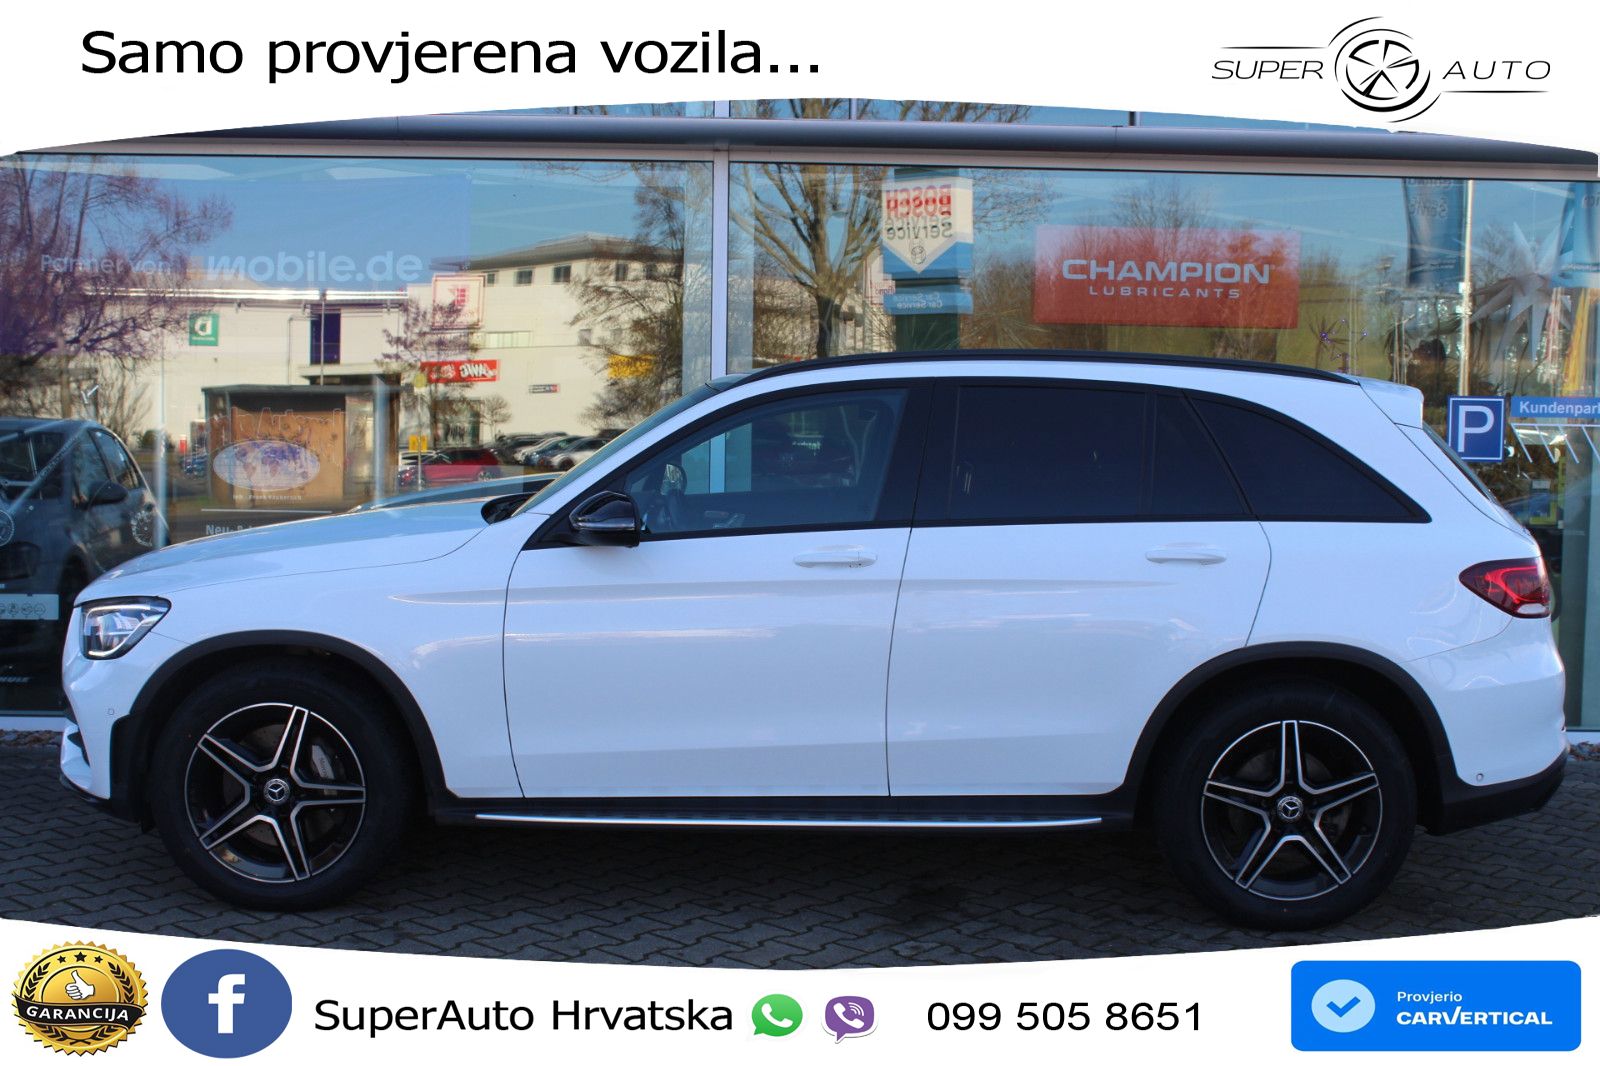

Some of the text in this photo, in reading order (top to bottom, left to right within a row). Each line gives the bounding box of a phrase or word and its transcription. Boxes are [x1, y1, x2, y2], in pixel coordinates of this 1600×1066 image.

[207, 251, 423, 281] mobile.de
[1062, 259, 1270, 284] CHAMPION
[1089, 286, 1240, 298] LUBRICANTS
[1457, 405, 1494, 453] P
